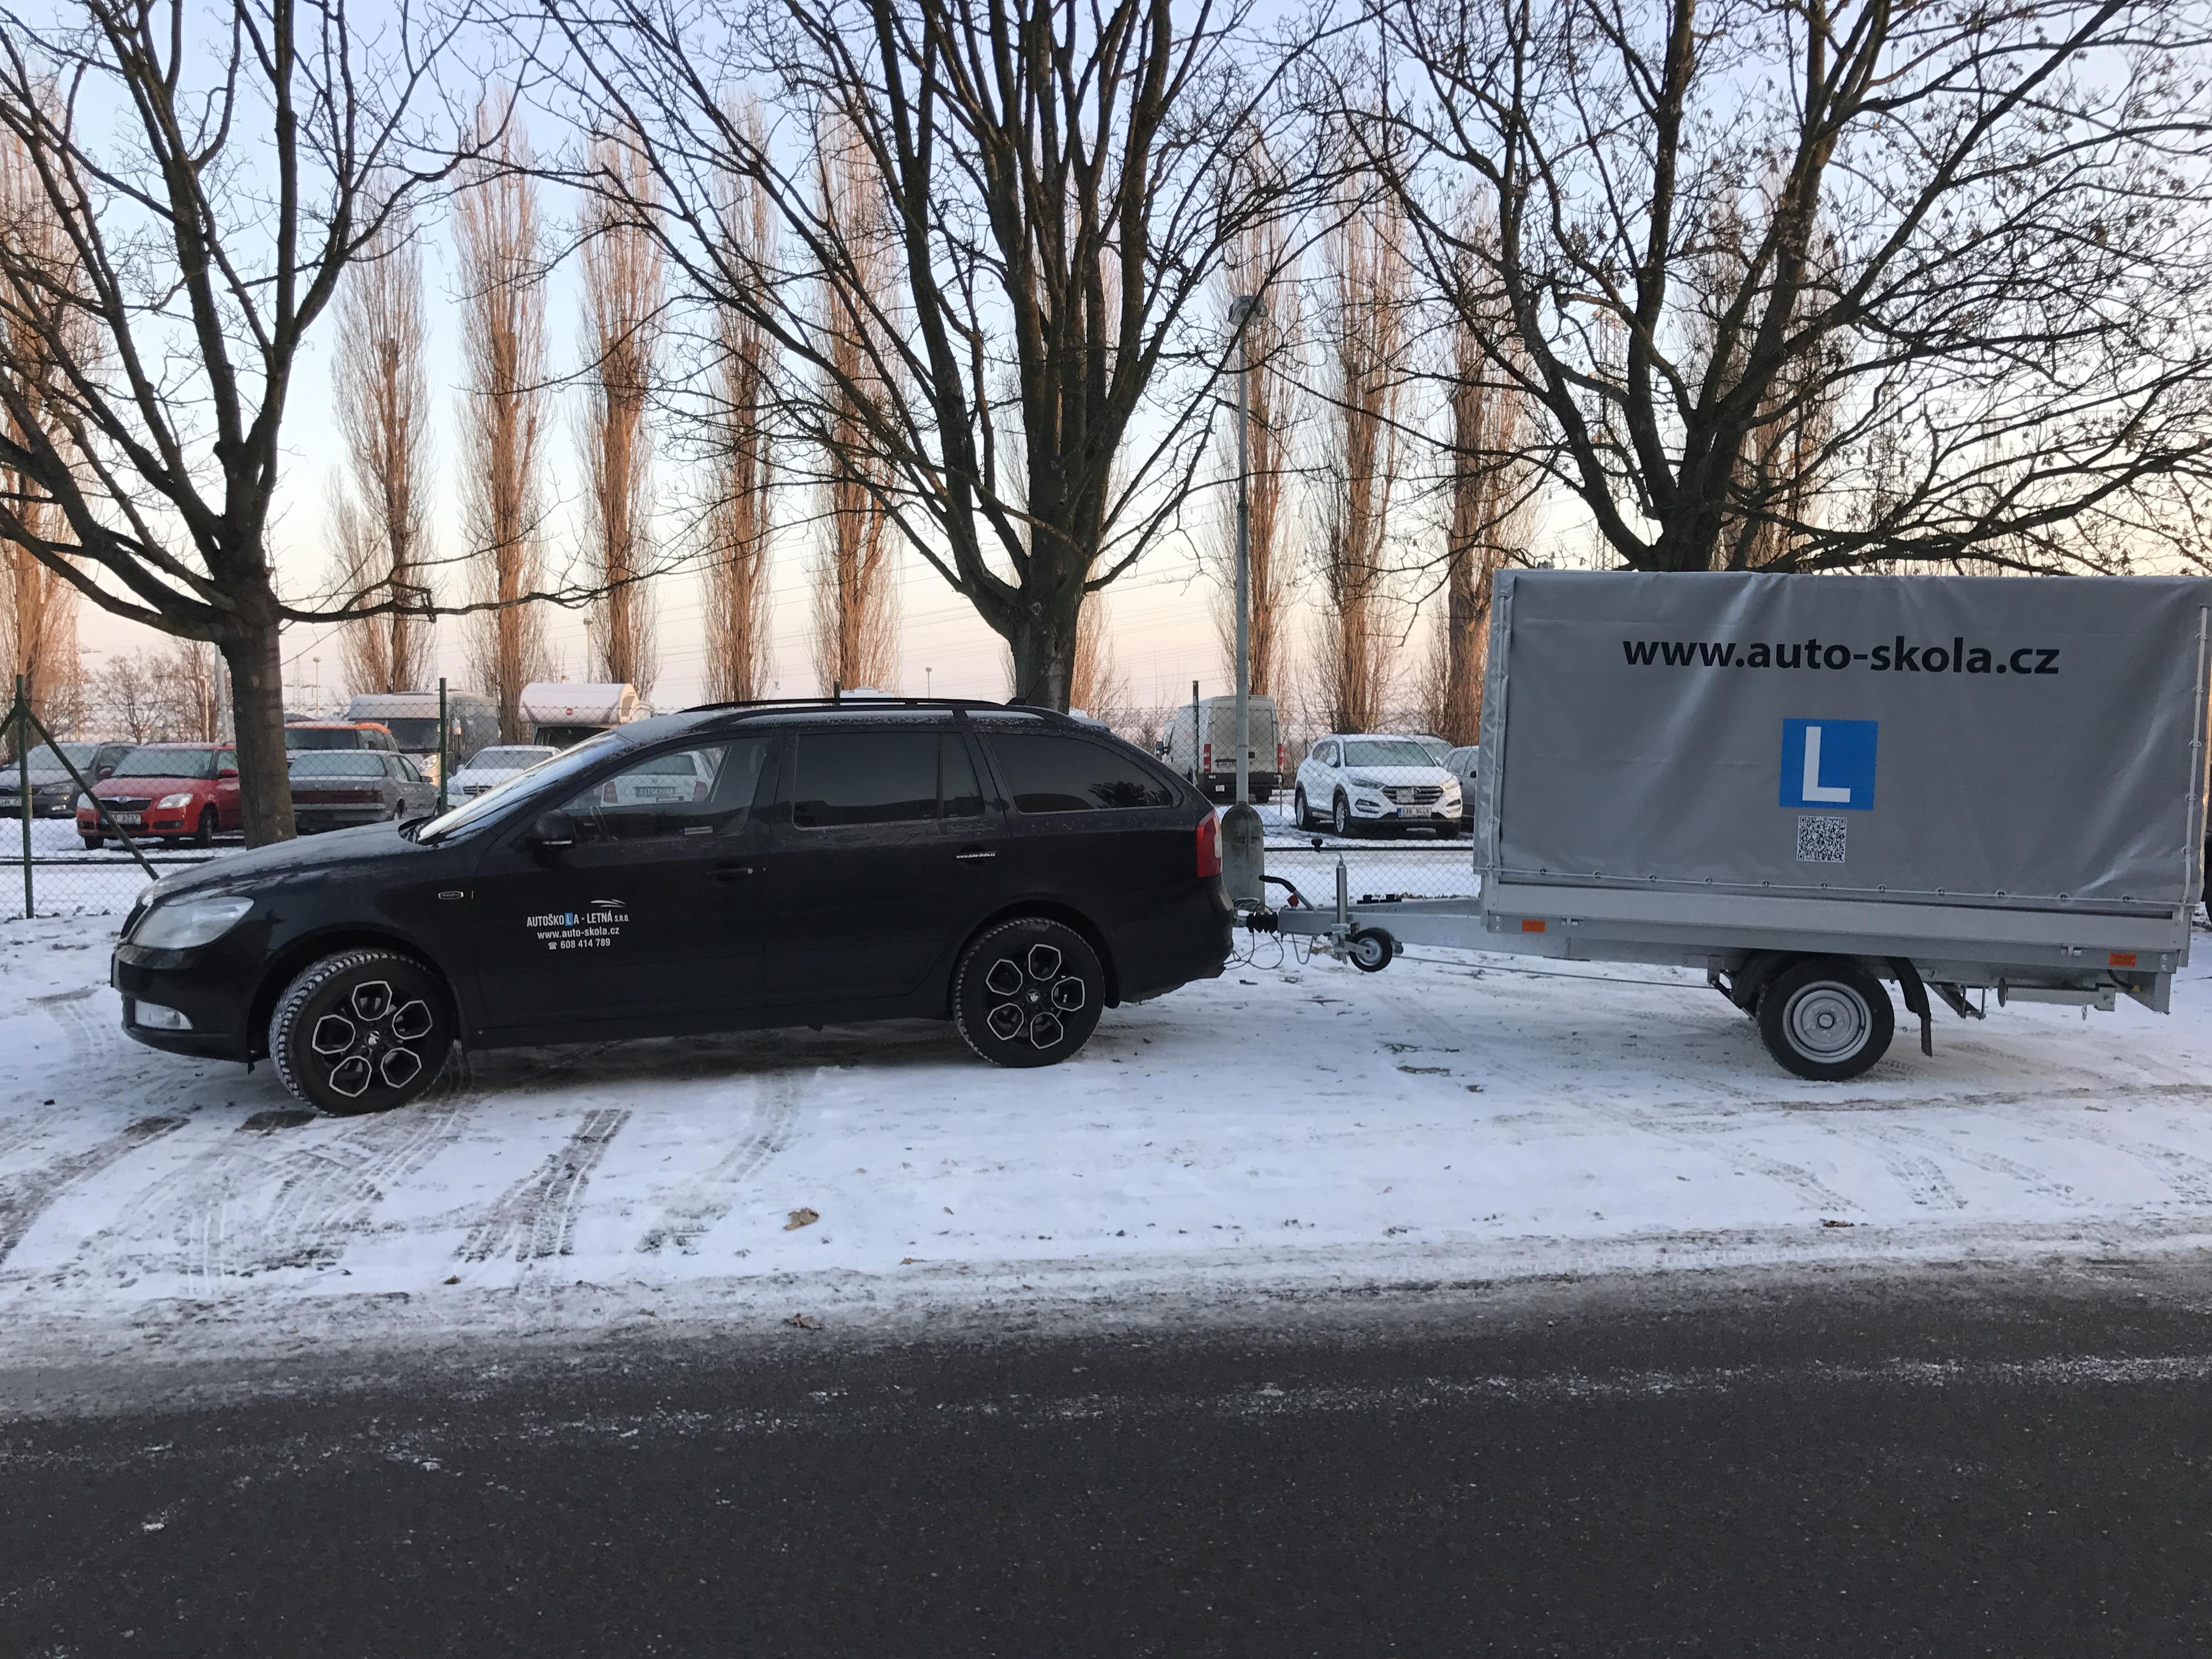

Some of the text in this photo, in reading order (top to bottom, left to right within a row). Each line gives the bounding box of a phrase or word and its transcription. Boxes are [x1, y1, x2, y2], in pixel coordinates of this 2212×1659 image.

[1623, 636, 2059, 674] www.auto-skola.cz
[1802, 726, 1850, 802] L
[526, 912, 580, 927] AUTOŠKOLA
[587, 910, 613, 924] LETNÁ
[537, 926, 620, 939] www.auto-skola.cz
[560, 938, 611, 949] 608 414 789
